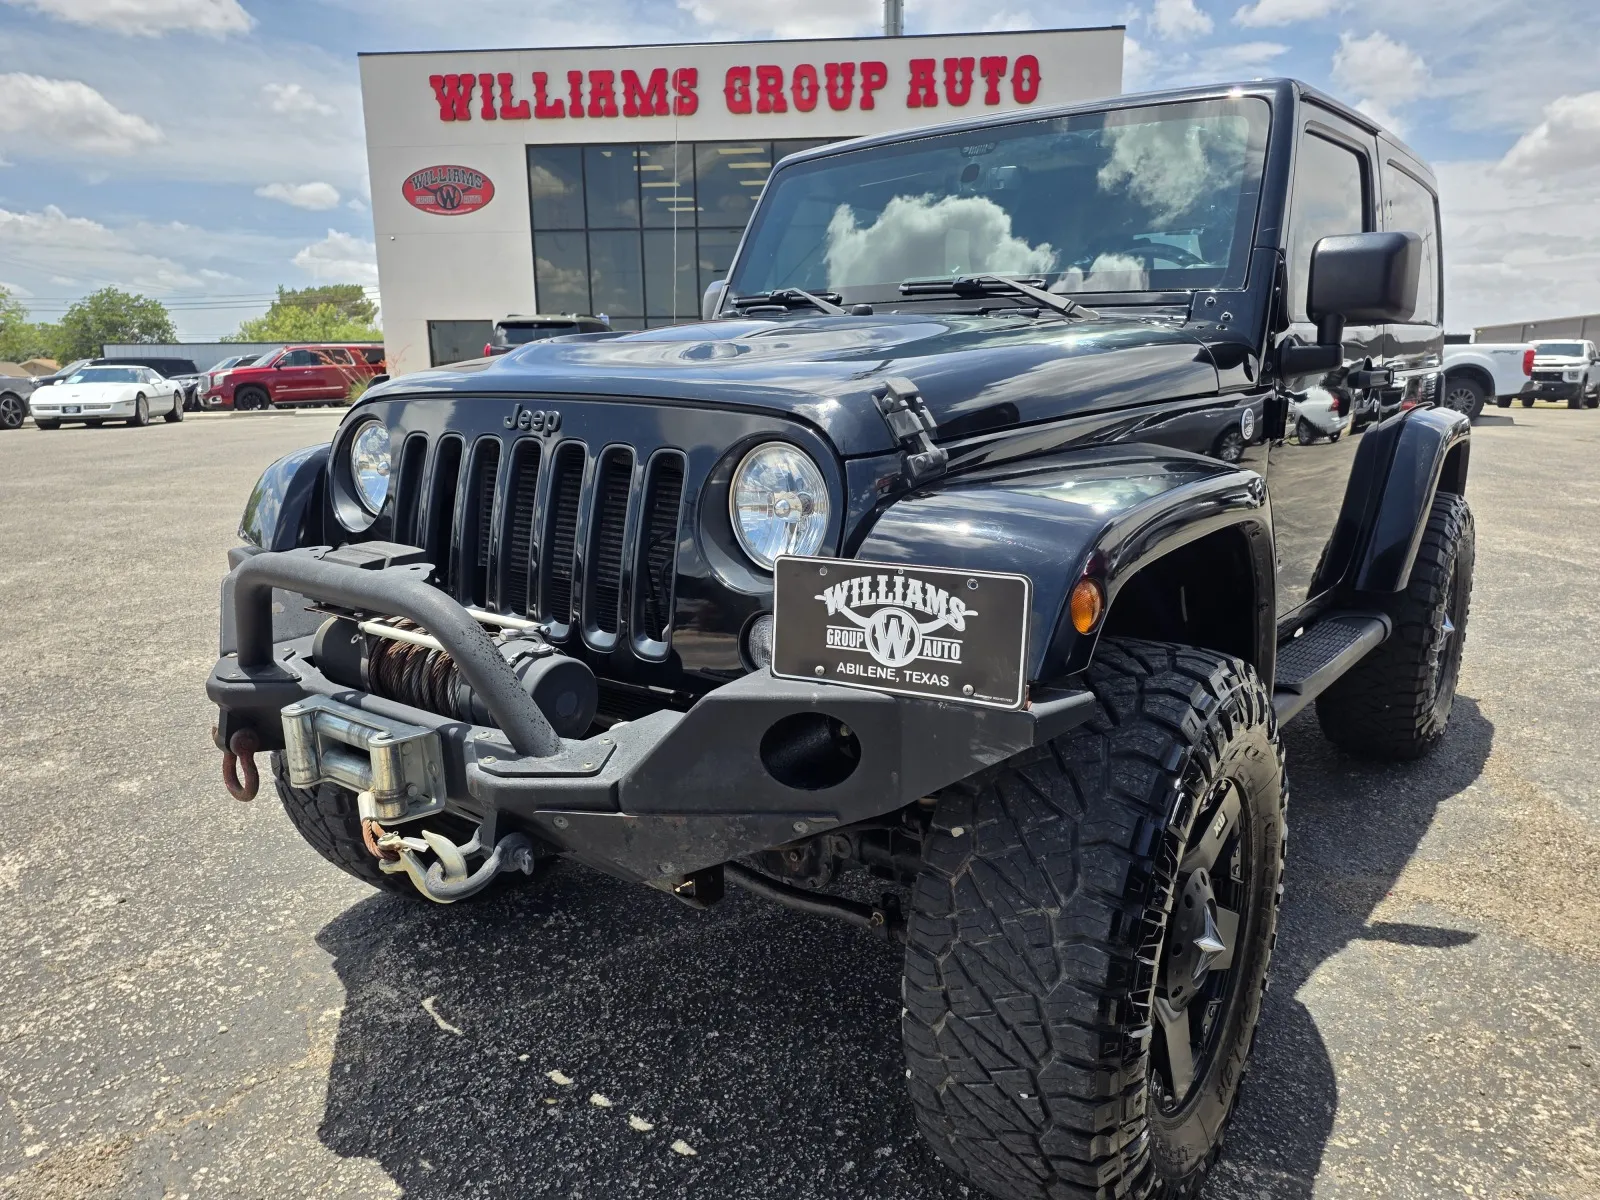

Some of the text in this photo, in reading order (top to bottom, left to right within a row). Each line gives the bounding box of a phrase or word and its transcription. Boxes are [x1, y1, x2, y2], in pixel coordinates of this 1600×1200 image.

[429, 55, 1042, 121] WILLIAMS GROUP AUTO
[412, 168, 483, 191] WILLIAMS
[503, 403, 562, 437] Jeep
[823, 574, 967, 632] WILLIAMS
[826, 613, 961, 661] GROUP W AUTO
[836, 661, 949, 687] ABILENE, TEXAS
